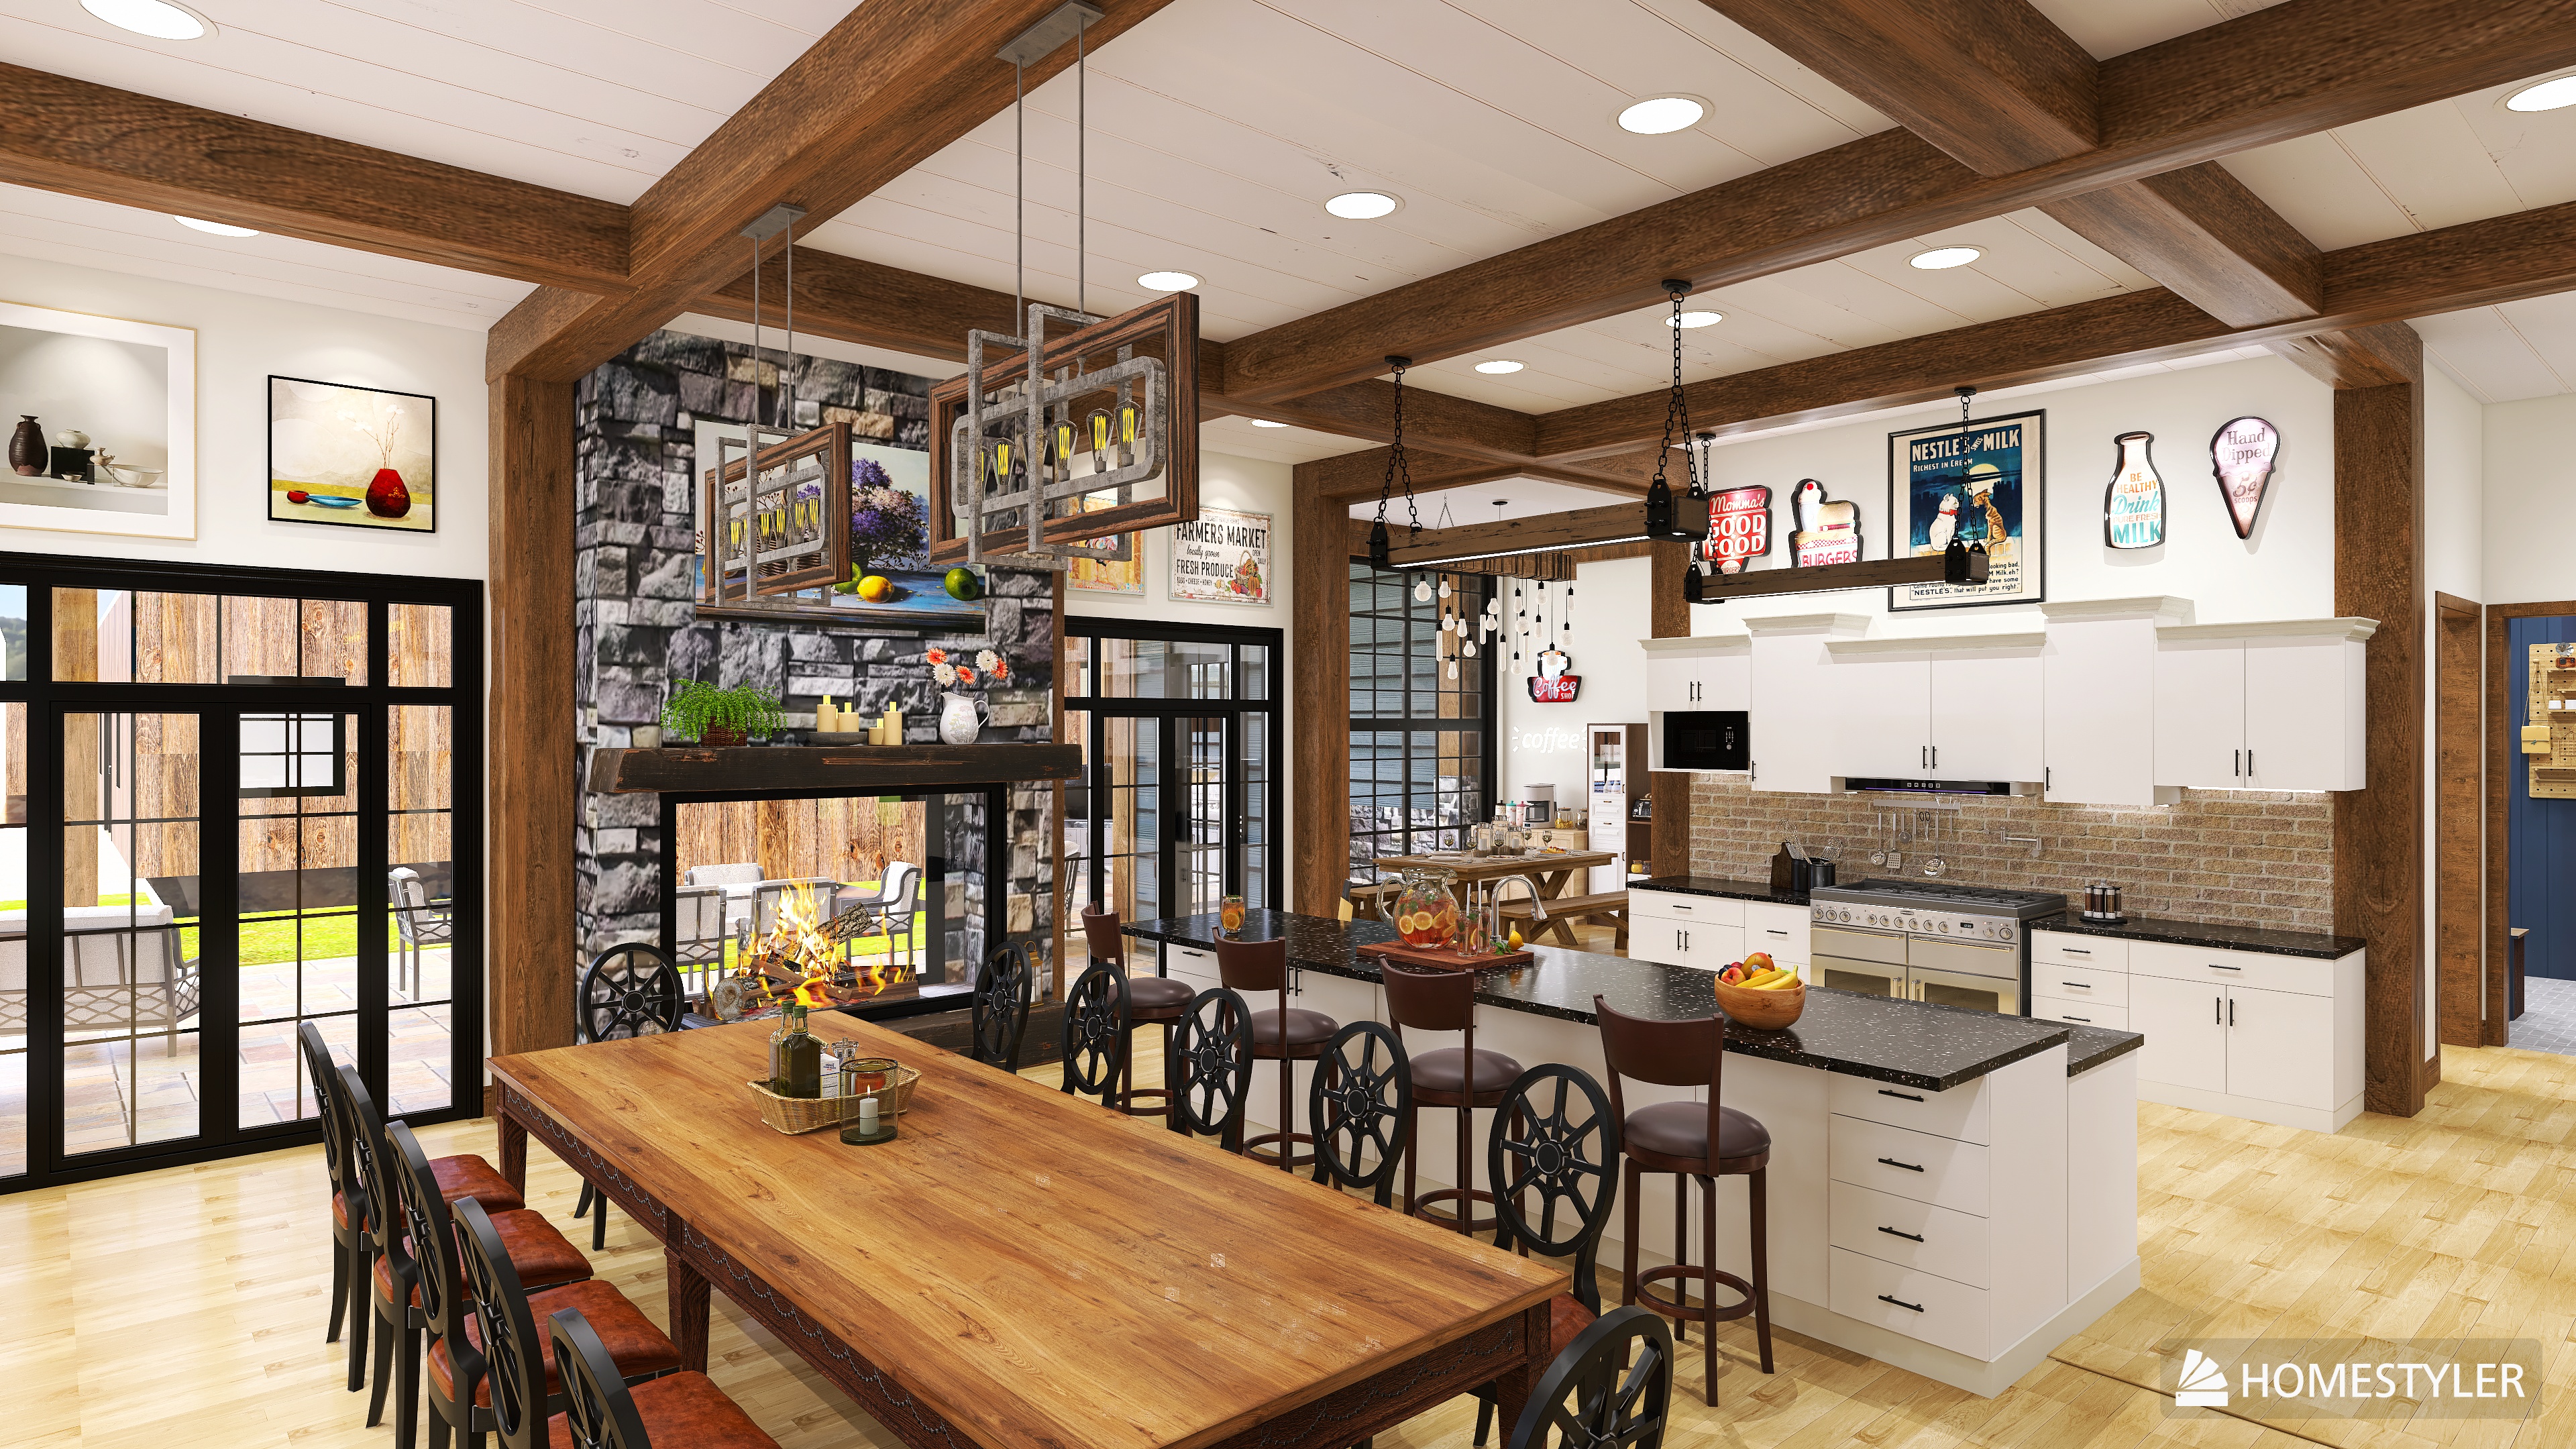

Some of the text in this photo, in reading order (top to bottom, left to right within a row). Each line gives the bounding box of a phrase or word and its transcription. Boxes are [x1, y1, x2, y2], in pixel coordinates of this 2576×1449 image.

[1983, 429, 2020, 451] MILK
[2227, 427, 2265, 445] Hand
[2222, 443, 2271, 465] Dipped
[2116, 479, 2158, 494] HEALTHY
[2130, 472, 2142, 482] BE
[1711, 494, 1765, 513] Momma's
[2112, 490, 2160, 515] Drink
[2234, 496, 2257, 504] scoops
[1709, 515, 1766, 539] GOOD
[2113, 513, 2162, 523] PURE FRESH
[1177, 521, 1267, 549] FARMERS MARKET
[2113, 520, 2161, 544] MILK
[1187, 544, 1220, 560] locally grown
[1709, 535, 1766, 557] FOOD
[1177, 559, 1234, 578] FRESH PRODUCE
[1802, 550, 1858, 568] BURGERS
[1533, 674, 1577, 700] Coffee
[1521, 727, 1580, 754] coffee
